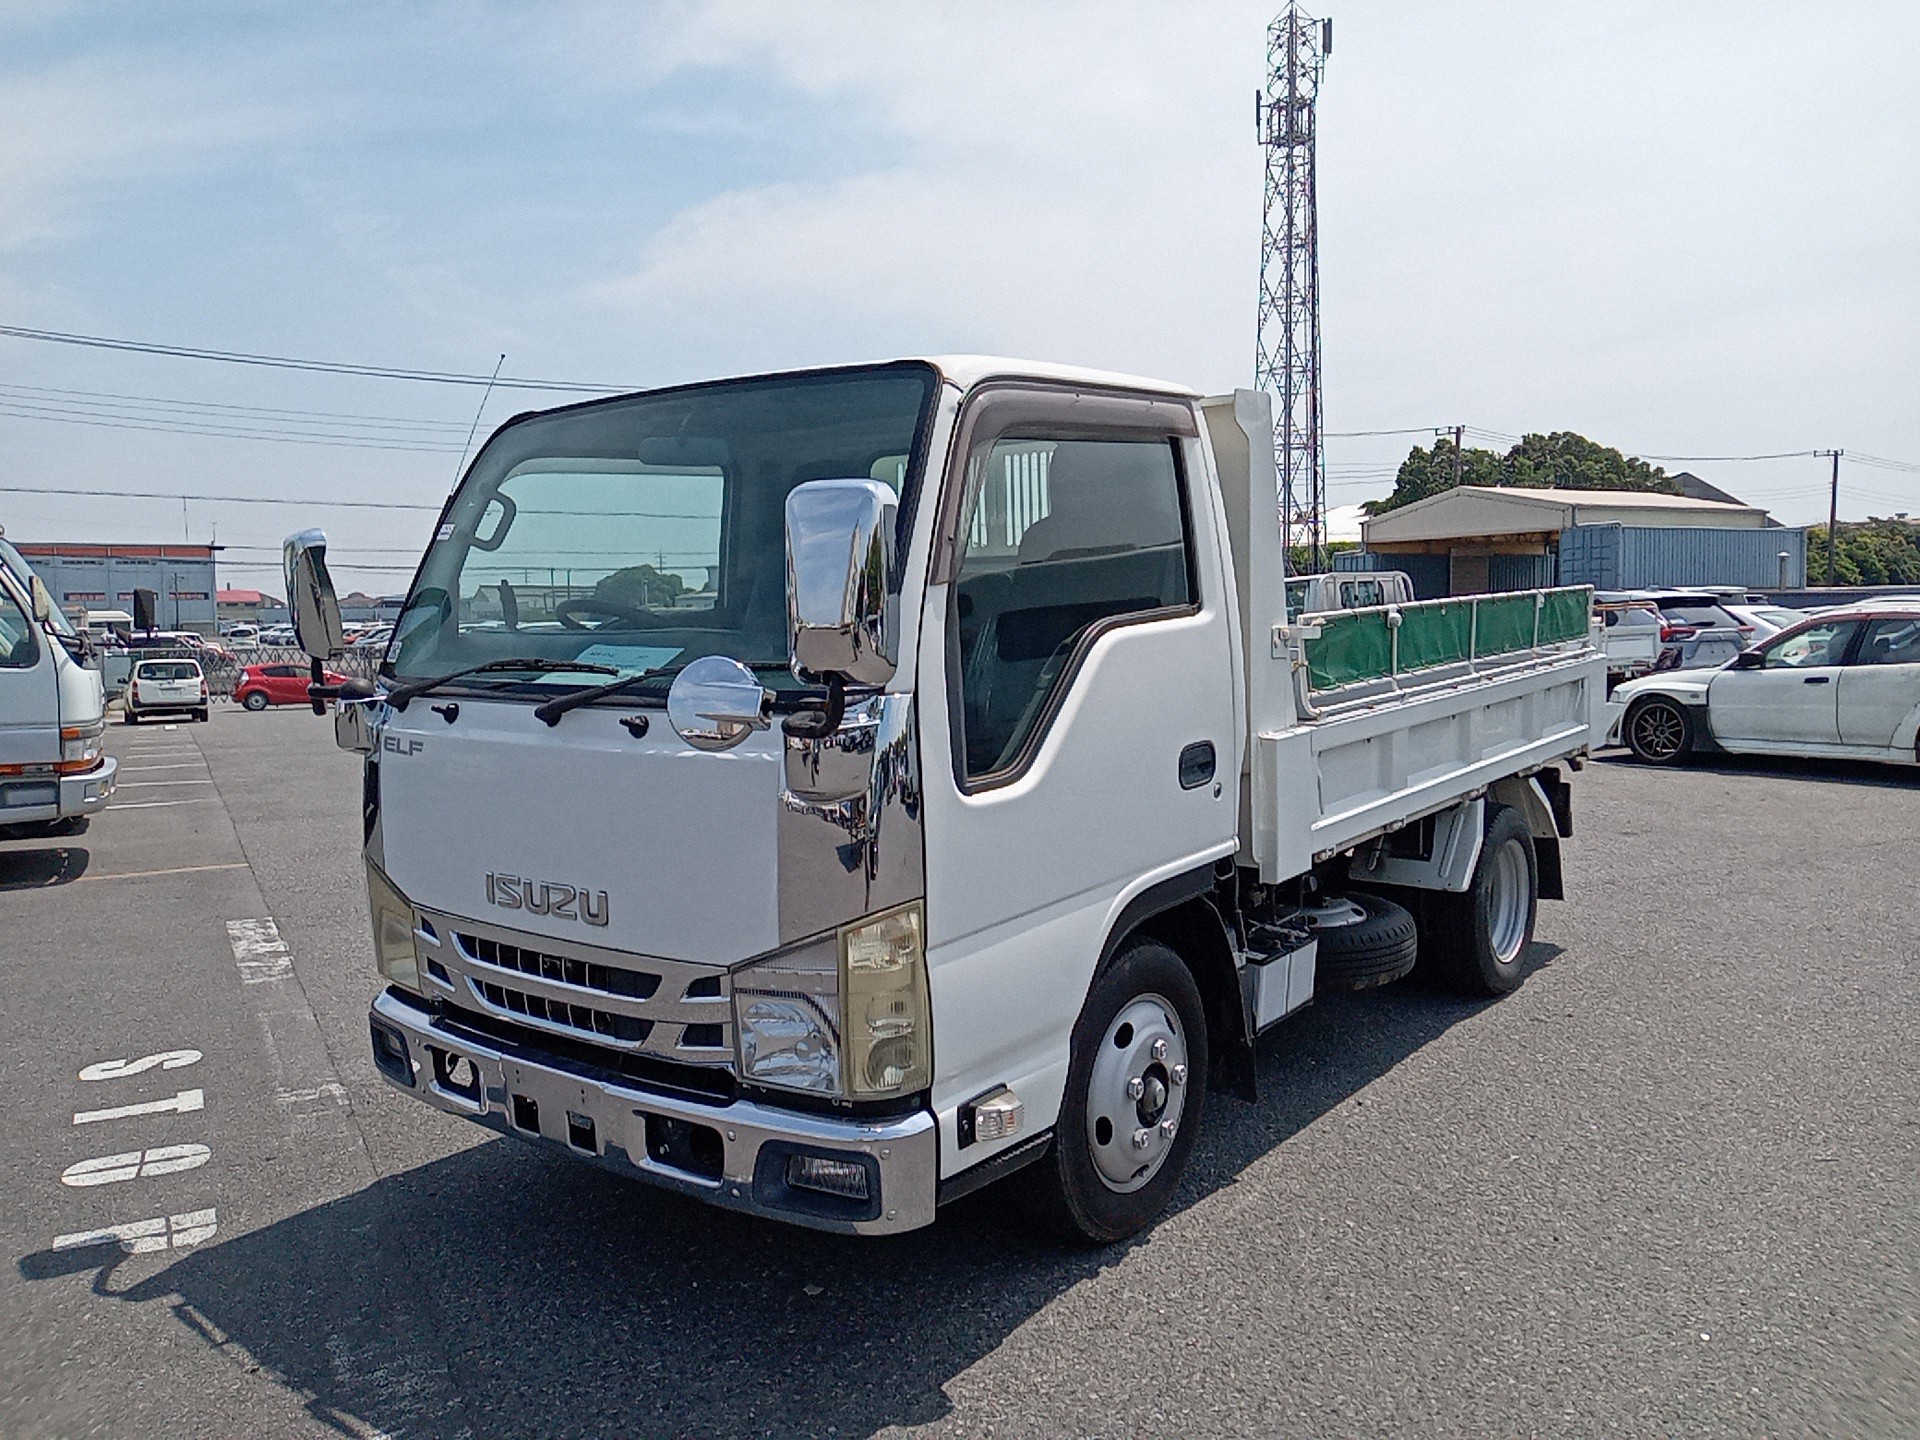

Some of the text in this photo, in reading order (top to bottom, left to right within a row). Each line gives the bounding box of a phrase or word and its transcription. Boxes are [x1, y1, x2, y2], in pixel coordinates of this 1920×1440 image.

[384, 735, 424, 757] ELF
[485, 870, 609, 927] ISUZU
[52, 1049, 218, 1254] STOP
